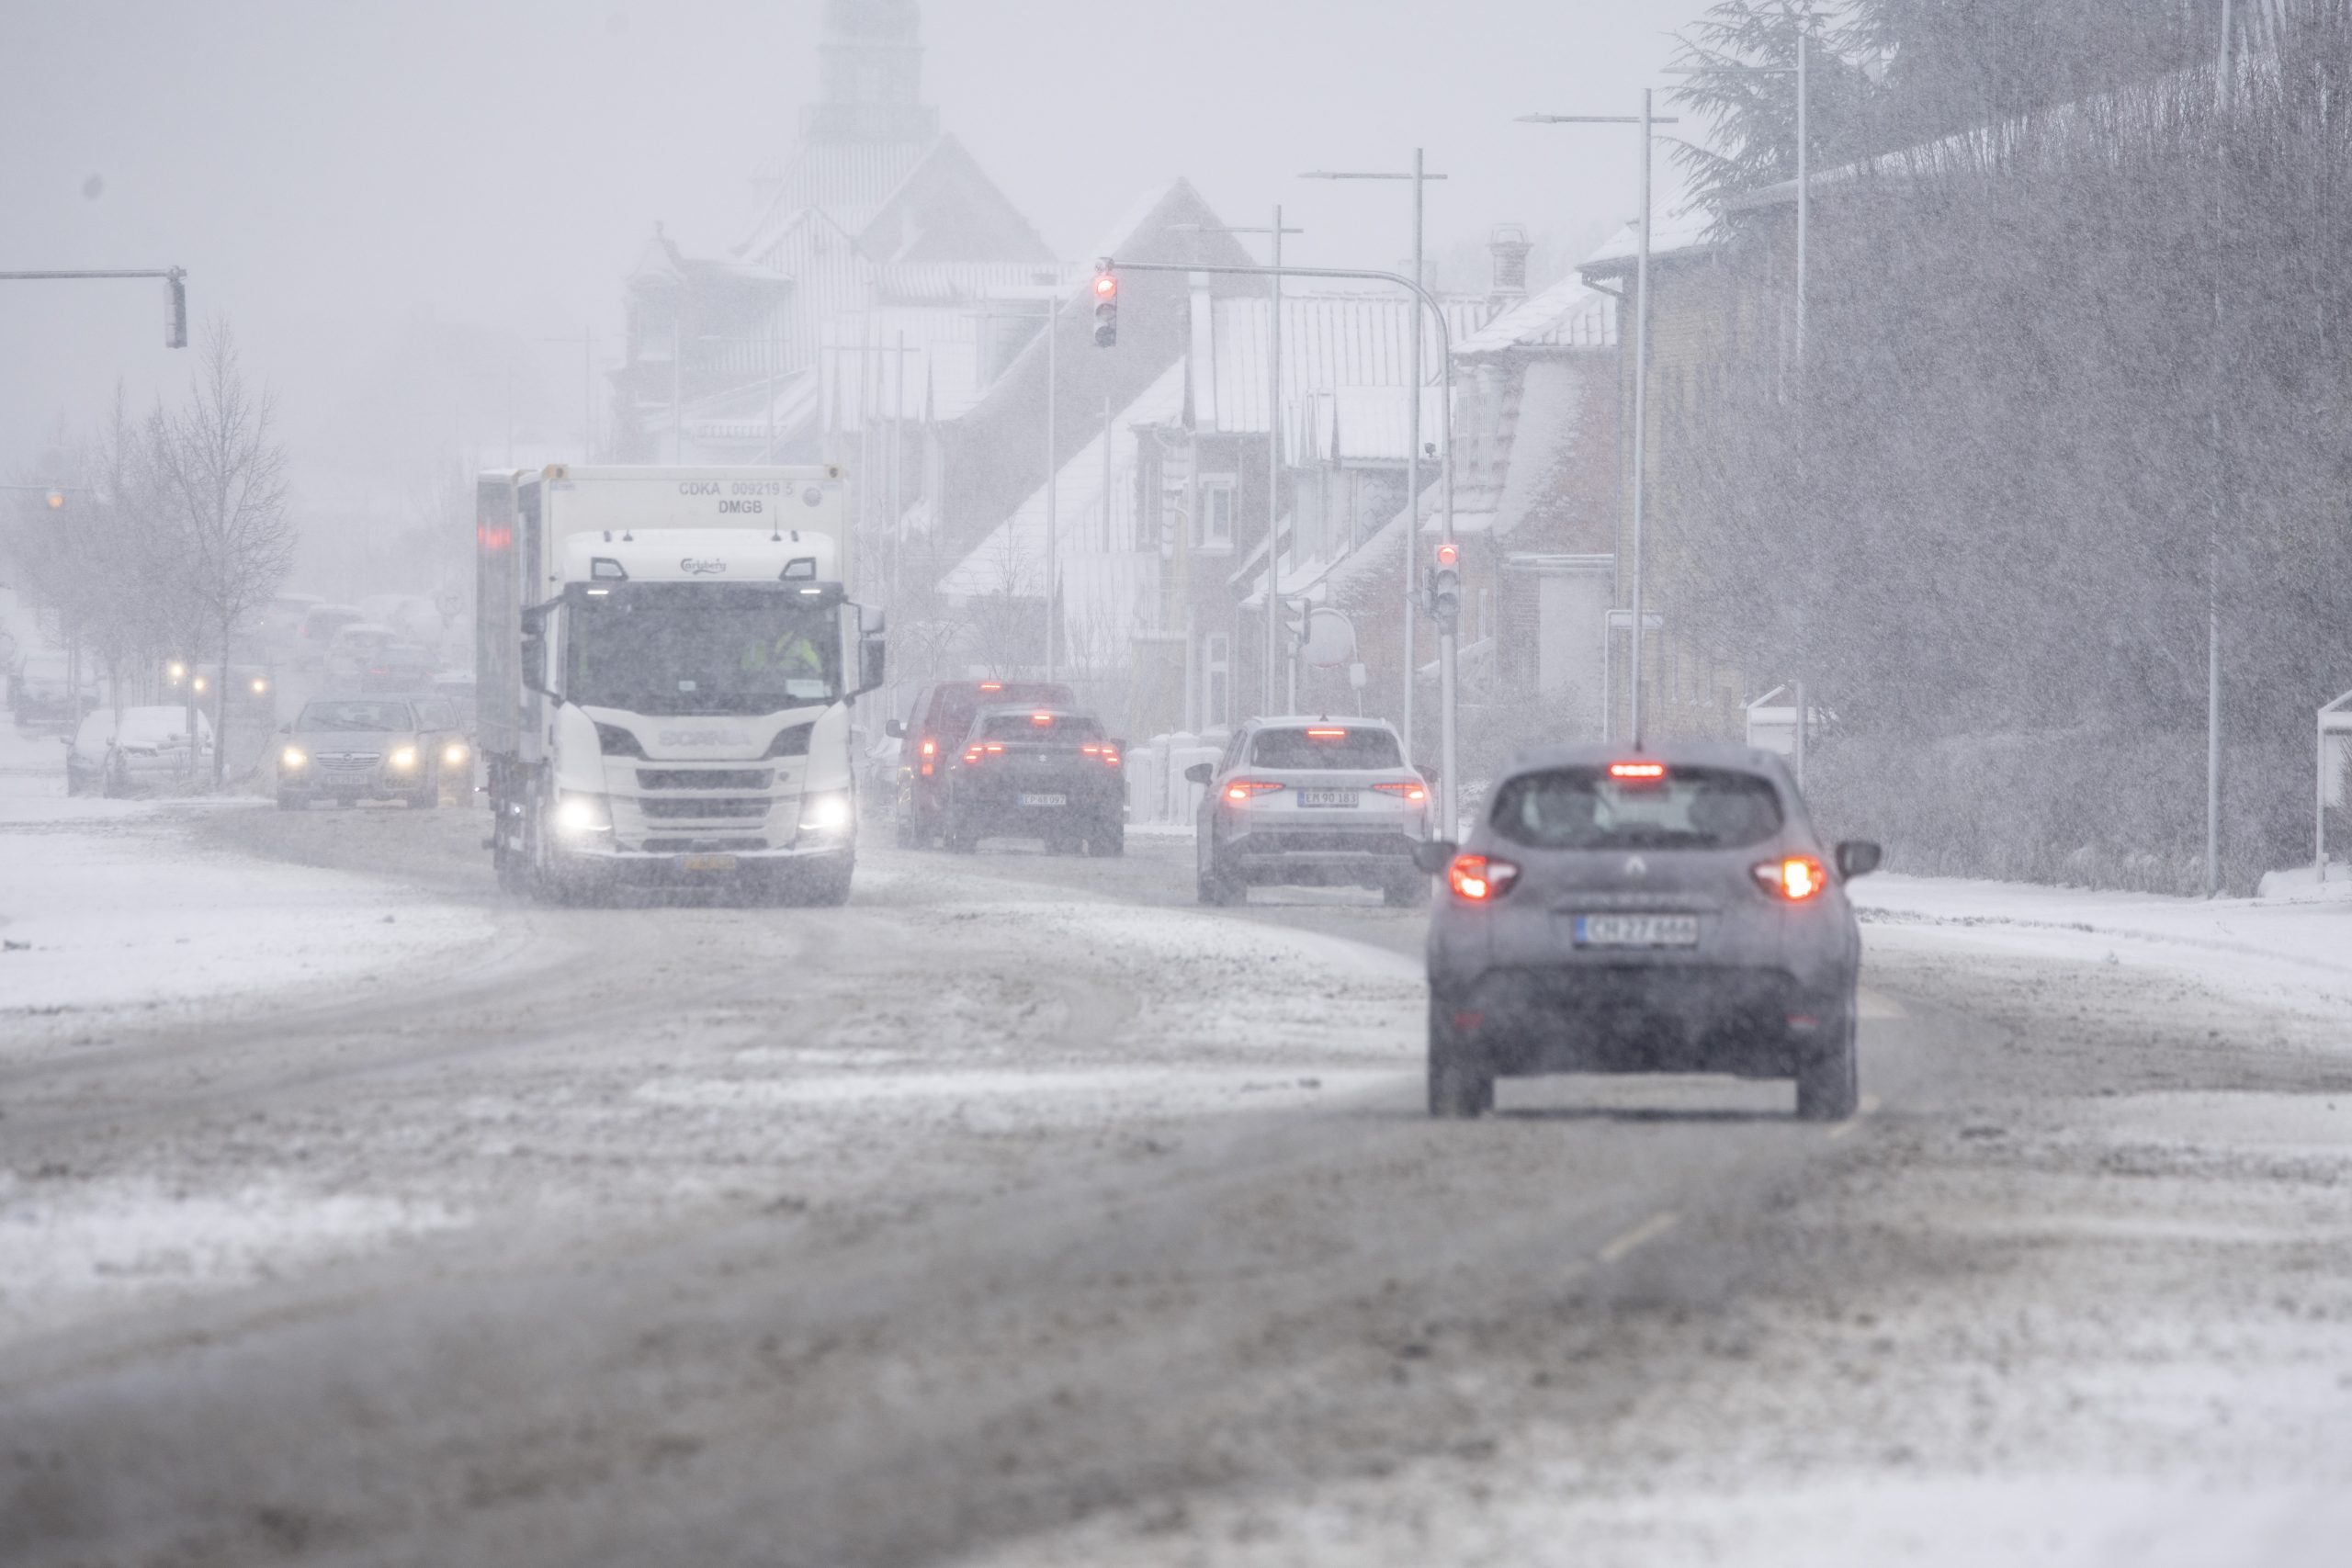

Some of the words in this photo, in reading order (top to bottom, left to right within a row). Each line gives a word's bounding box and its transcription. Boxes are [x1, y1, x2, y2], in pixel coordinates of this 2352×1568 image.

[679, 481, 720, 495] CDKA
[731, 481, 780, 495] 009219
[786, 481, 794, 495] 5
[718, 500, 763, 513] DMGB
[680, 558, 727, 575] Carlsberg
